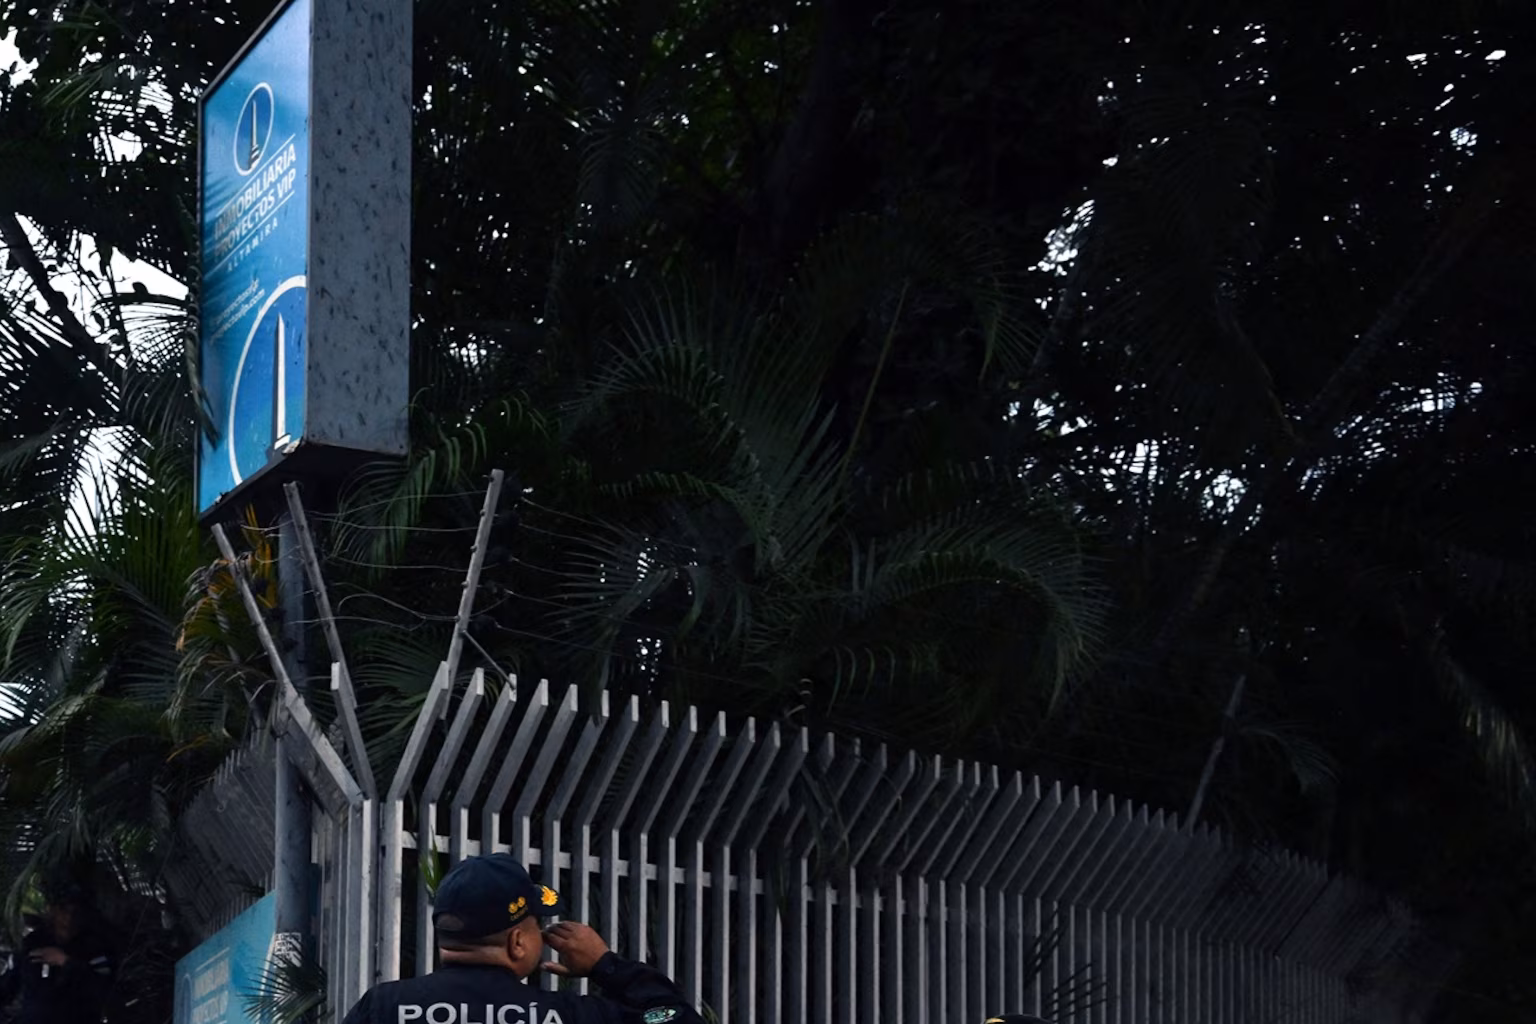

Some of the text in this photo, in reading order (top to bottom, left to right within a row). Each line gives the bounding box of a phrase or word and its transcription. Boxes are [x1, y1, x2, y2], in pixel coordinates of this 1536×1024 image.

[214, 143, 296, 240] INMOBILIARIA
[214, 168, 296, 260] PROYECTOS VIP
[227, 217, 278, 272] ALTAMIRA
